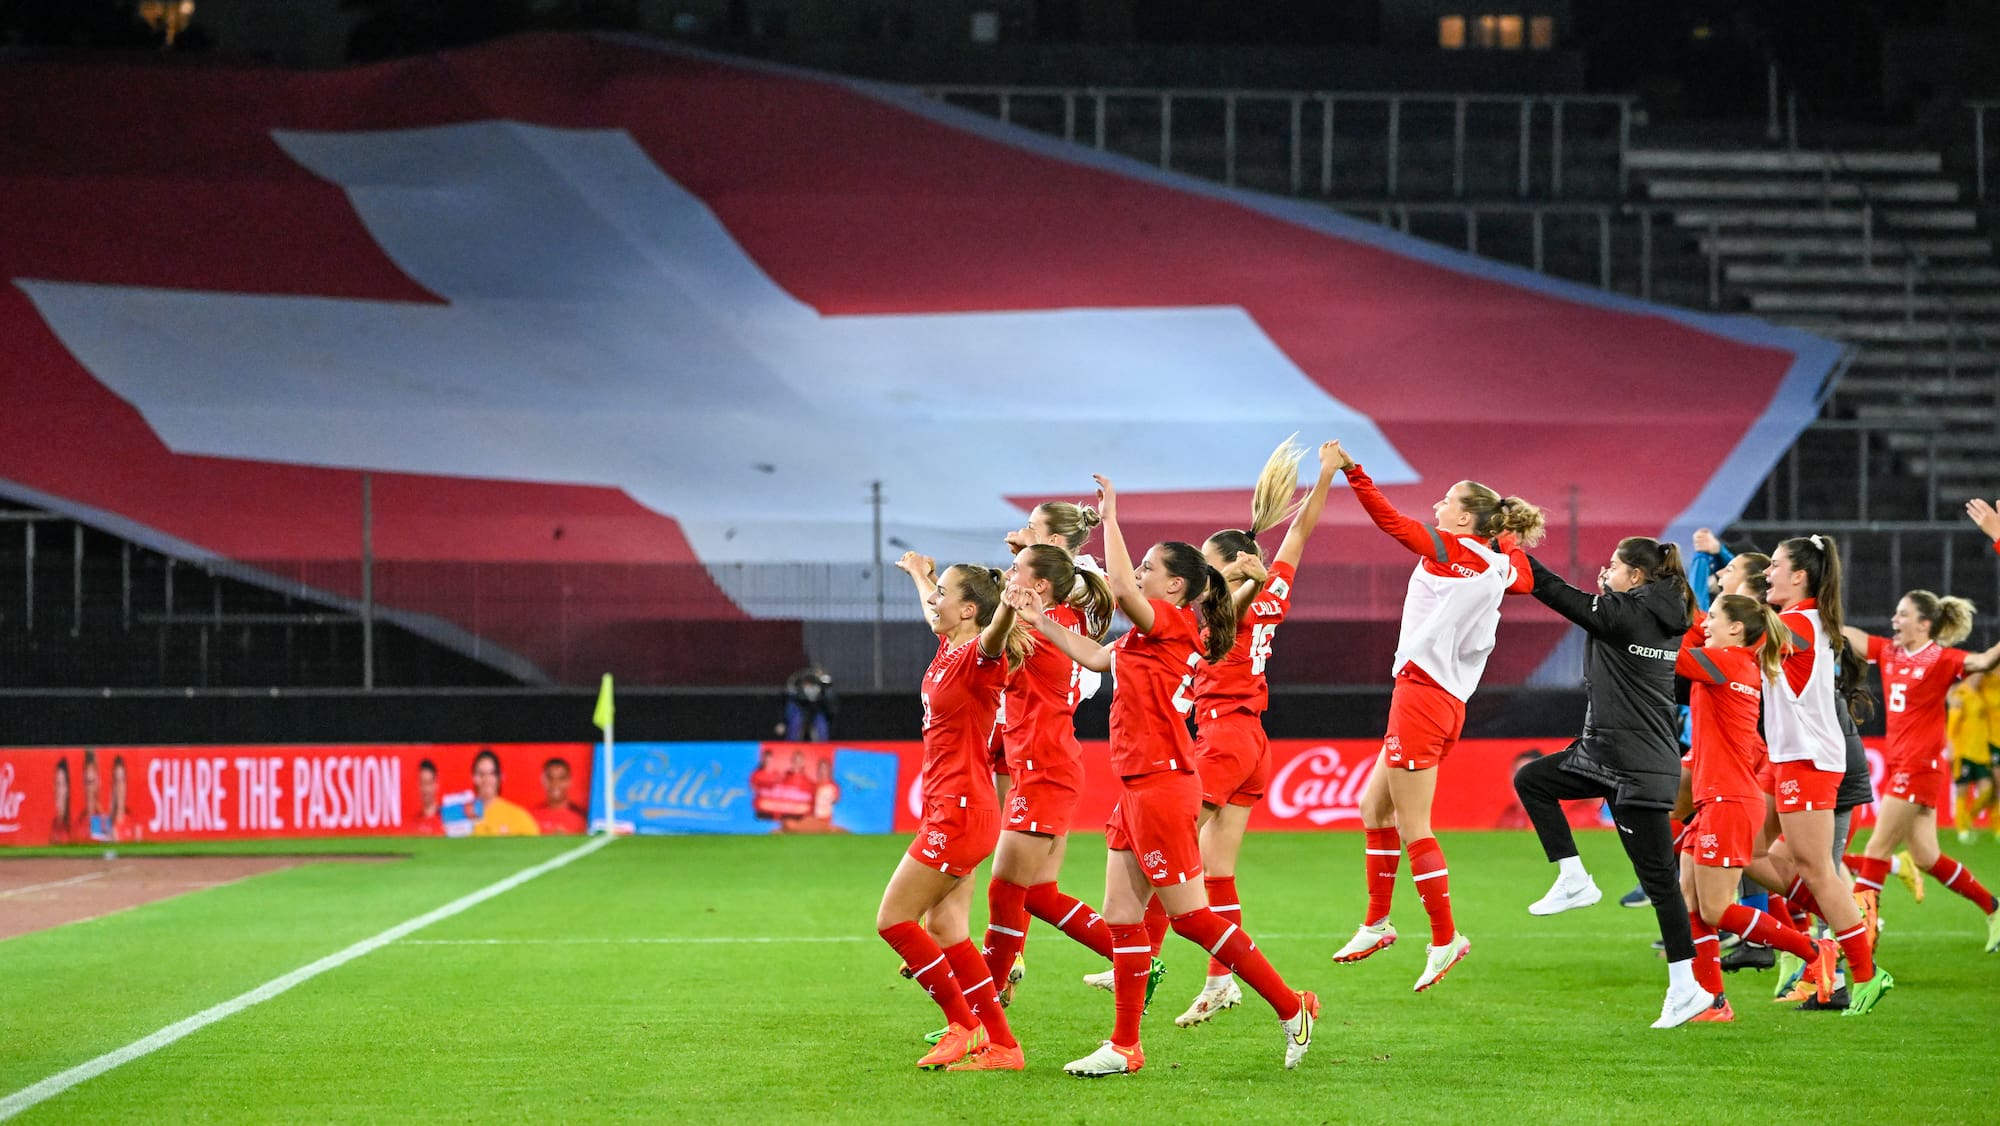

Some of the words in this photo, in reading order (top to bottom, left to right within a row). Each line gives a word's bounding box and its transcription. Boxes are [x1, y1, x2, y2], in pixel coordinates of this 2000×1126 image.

[1628, 644, 1663, 659] CREDIT
[1889, 683, 1907, 712] 15
[148, 758, 228, 832] SHARE
[234, 756, 284, 831] THE
[293, 755, 402, 825] PASSION
[1268, 746, 1378, 818] Caill
